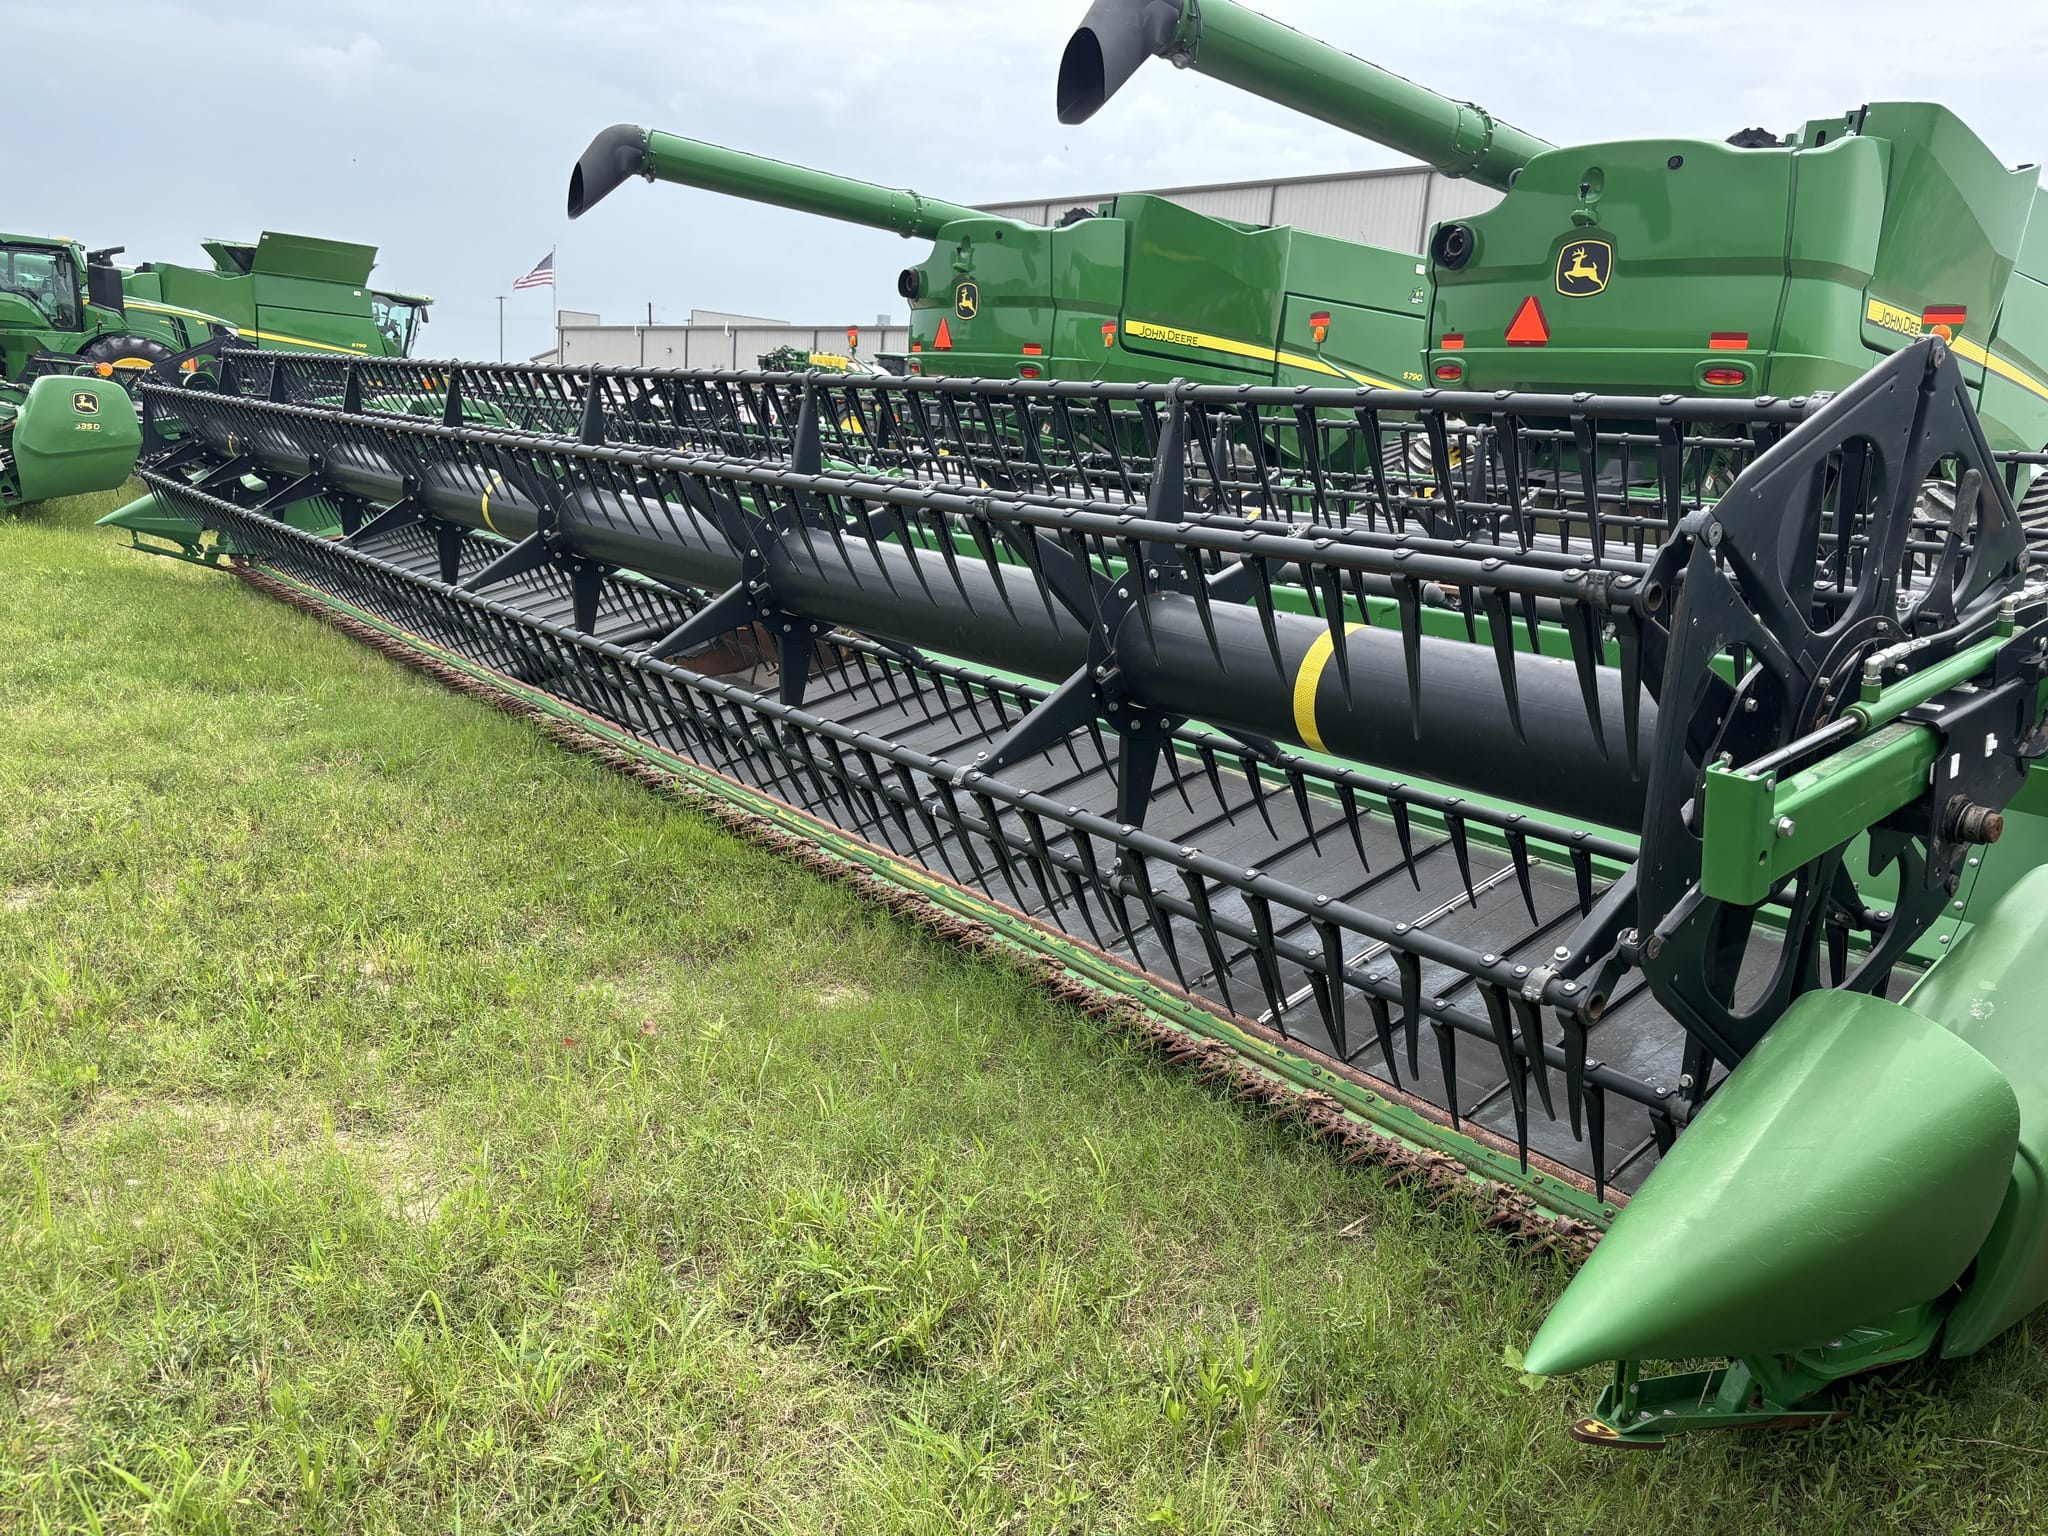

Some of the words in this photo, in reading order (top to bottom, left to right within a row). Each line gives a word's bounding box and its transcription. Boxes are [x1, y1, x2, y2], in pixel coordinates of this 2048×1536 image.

[1879, 308, 1903, 329] JOHN
[1903, 317, 1922, 336] DEE
[1139, 325, 1165, 339] JOHN
[1167, 330, 1199, 345] DEERE
[1402, 371, 1423, 382] S790
